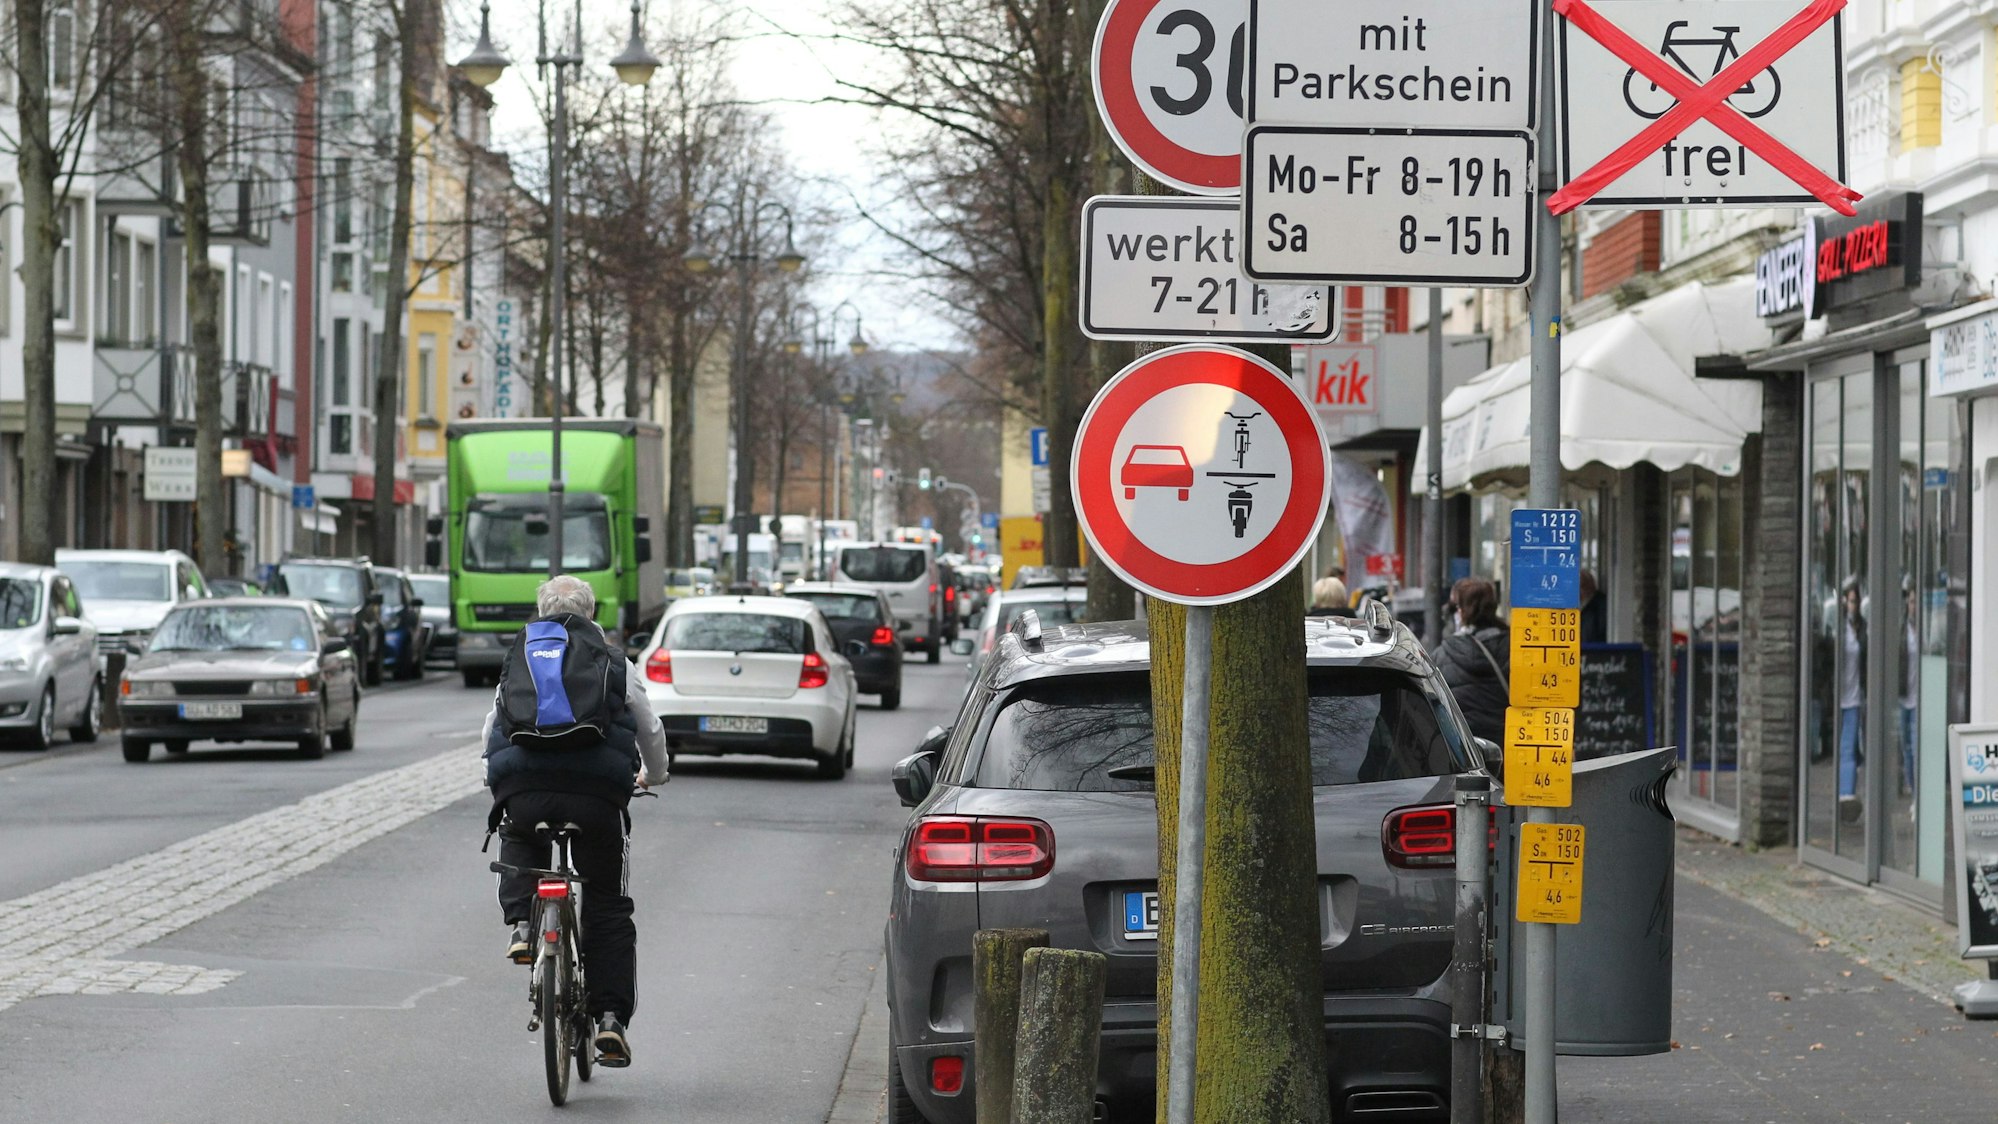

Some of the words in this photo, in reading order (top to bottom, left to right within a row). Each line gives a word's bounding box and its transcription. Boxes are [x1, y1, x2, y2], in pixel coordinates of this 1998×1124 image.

[1360, 16, 1426, 51] mit
[1273, 63, 1512, 101] Parkschein
[1662, 136, 1746, 177] frei
[1268, 154, 1381, 195] Mo-Fr
[1401, 156, 1484, 198] 8-19
[1495, 158, 1511, 197] h
[1267, 212, 1308, 252] Sa
[1400, 214, 1482, 255] 8-15
[1493, 216, 1510, 257] h
[1151, 276, 1237, 315] 7-21
[1315, 355, 1370, 405] kik
[1541, 513, 1577, 527] 1212
[1524, 529, 1532, 543] S
[1551, 529, 1576, 543] 150
[1550, 612, 1576, 626] 503
[1524, 628, 1532, 642] S
[1551, 628, 1576, 642] 100
[1561, 652, 1575, 667] 1,6
[1541, 674, 1558, 689] 4,3
[1544, 712, 1569, 725] 504
[1518, 727, 1526, 740] S
[1544, 728, 1569, 741] 150
[1551, 751, 1567, 766] 4,4
[1534, 773, 1550, 788] 4,6
[1557, 828, 1580, 842] 502
[1533, 844, 1540, 857] S
[1557, 845, 1580, 859] 150
[1546, 889, 1562, 905] 4,6
[1131, 914, 1139, 924] D
[1389, 925, 1455, 934] AIRCROSS
